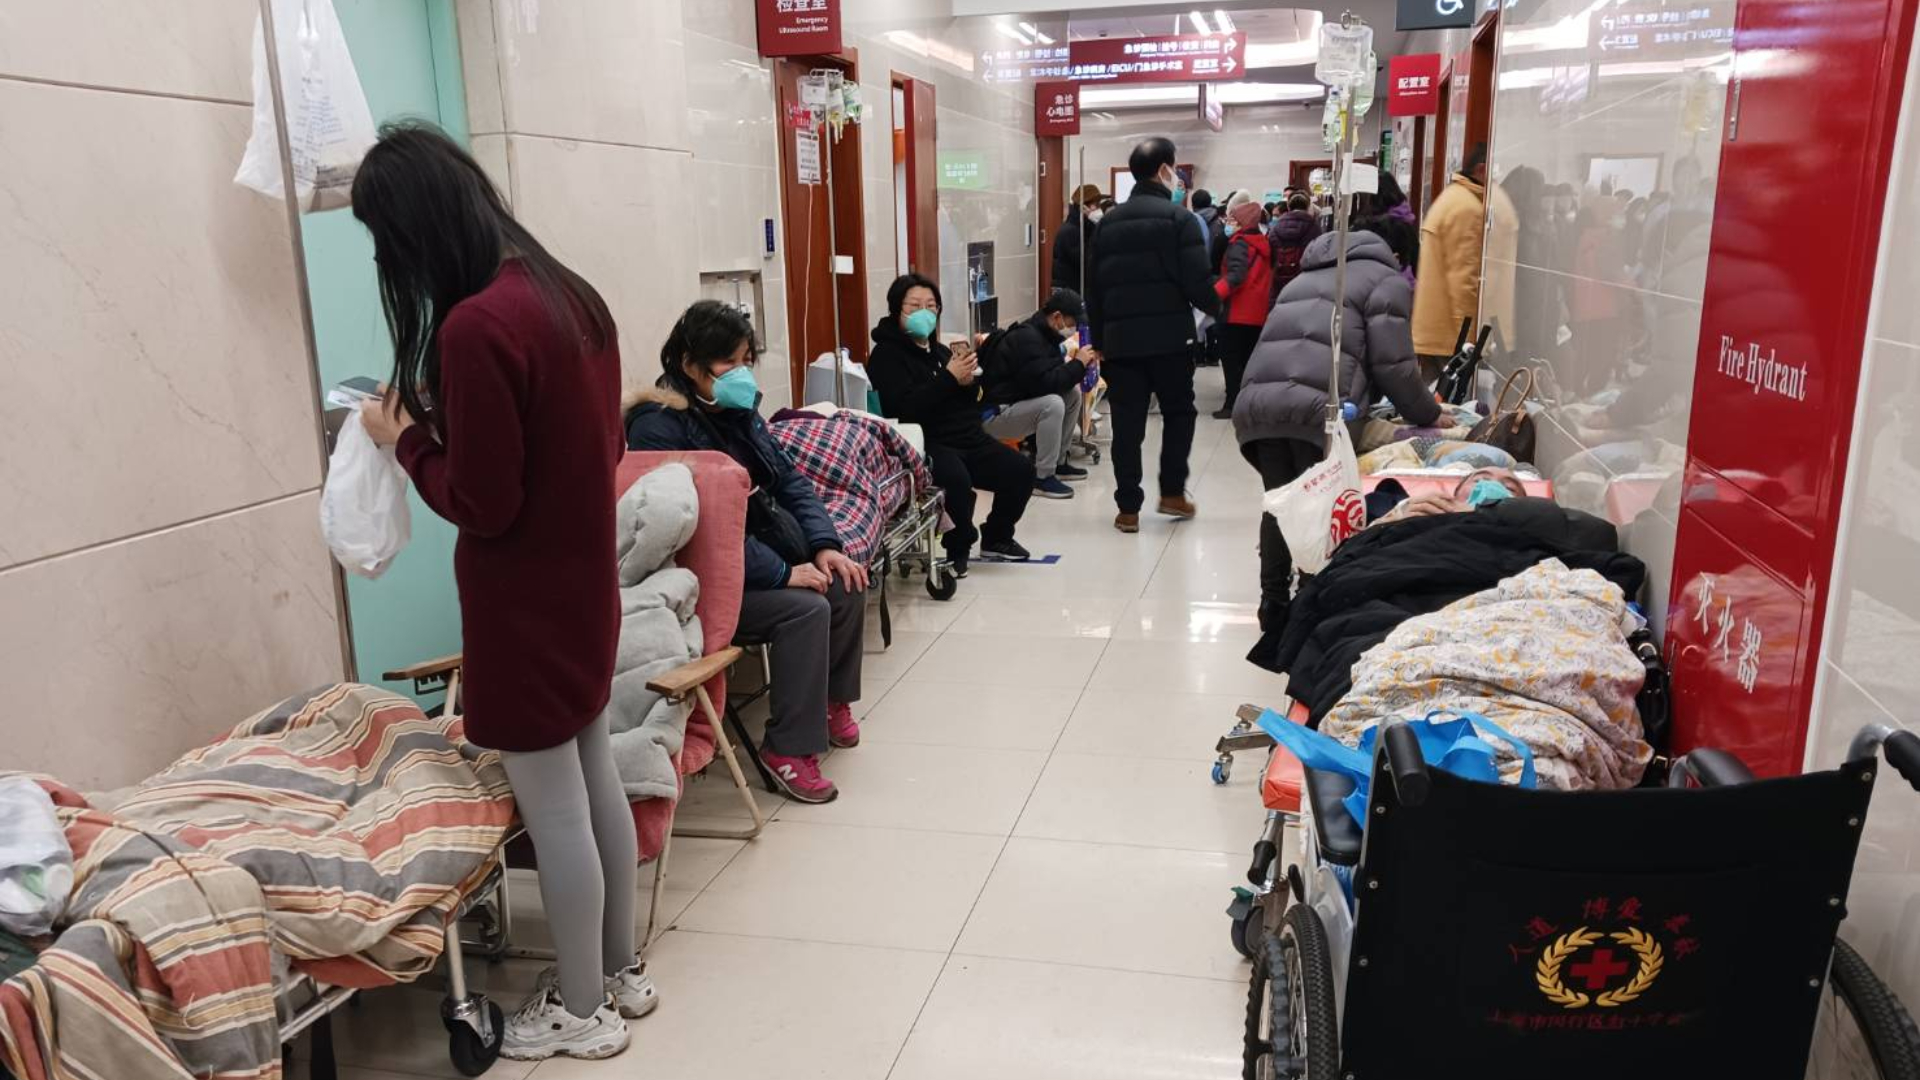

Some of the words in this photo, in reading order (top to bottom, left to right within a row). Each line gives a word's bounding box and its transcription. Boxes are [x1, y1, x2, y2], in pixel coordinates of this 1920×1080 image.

[1717, 335, 1744, 380] Fire
[1745, 342, 1808, 402] Hydrant
[1694, 571, 1762, 694] 灭火器
